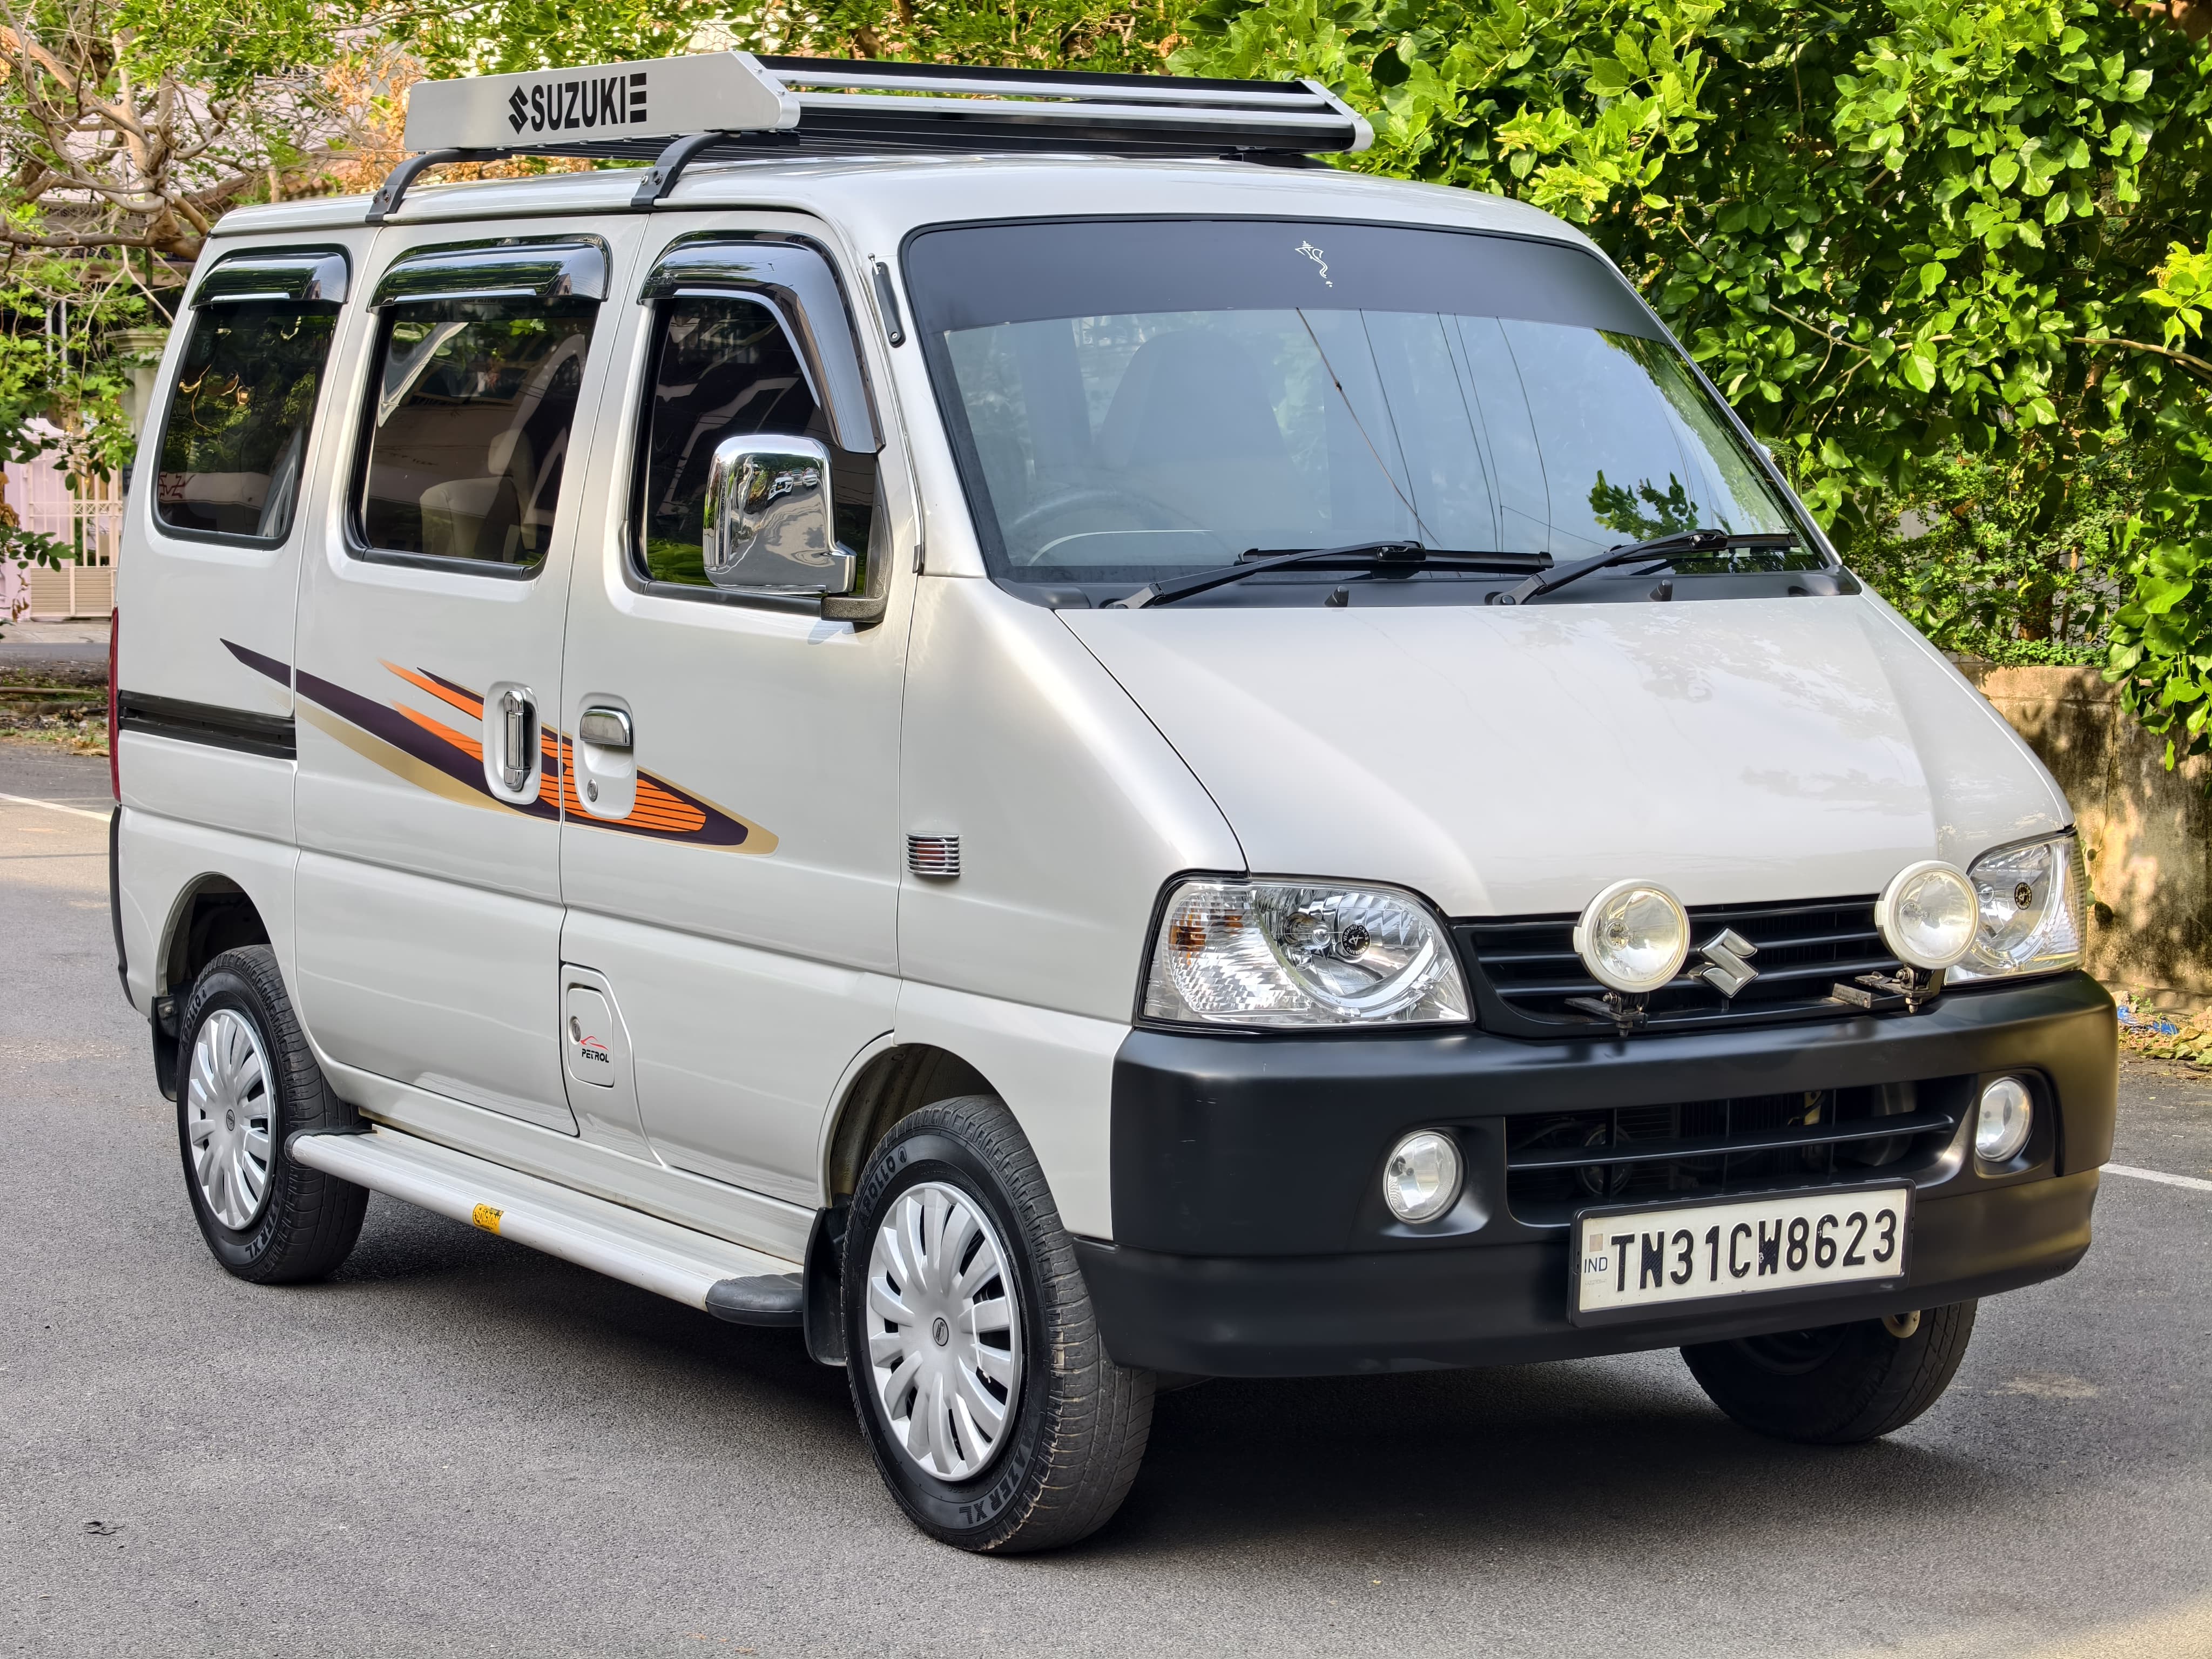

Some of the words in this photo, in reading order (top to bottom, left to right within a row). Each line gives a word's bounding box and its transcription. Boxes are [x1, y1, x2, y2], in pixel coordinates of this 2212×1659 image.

[530, 76, 627, 133] SUZUKI
[1343, 925, 1358, 942] VISHNU
[1359, 926, 1369, 941] CARS
[1346, 946, 1367, 955] CHENNAI
[582, 1048, 610, 1063] PETROL
[1611, 1208, 1897, 1292] TN31CW8623
[1584, 1256, 1608, 1274] IND
